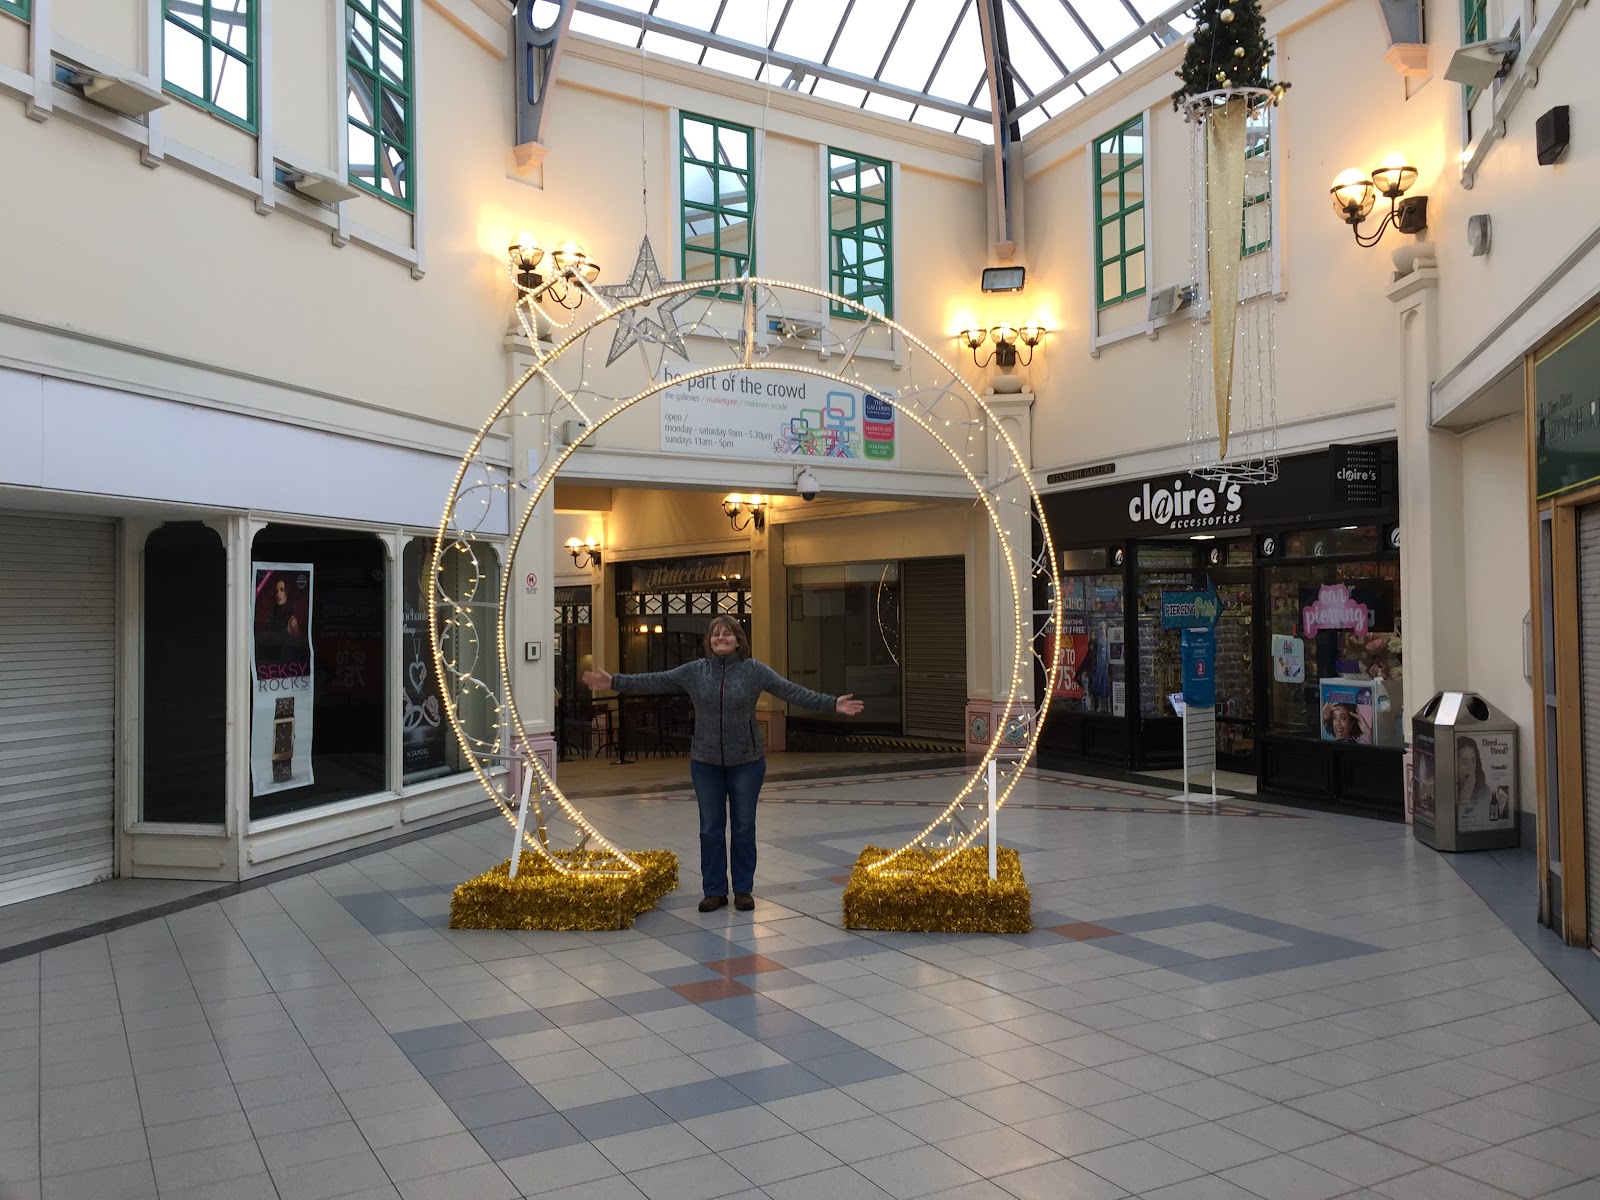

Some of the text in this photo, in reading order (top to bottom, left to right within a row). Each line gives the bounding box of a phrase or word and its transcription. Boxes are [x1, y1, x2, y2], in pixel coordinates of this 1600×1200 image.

[688, 374, 716, 392] part
[722, 374, 736, 392] of
[740, 376, 762, 395] the
[767, 383, 806, 400] crowd
[664, 392, 675, 400] the
[676, 393, 700, 402] galleries
[706, 396, 737, 407] marketgate
[664, 413, 682, 423] open
[1549, 407, 1584, 444] WATCH
[665, 423, 693, 435] monday
[699, 426, 726, 438] saturday
[728, 428, 743, 438] 9am
[749, 431, 773, 441] 5.30pm
[664, 435, 692, 446] sundays
[695, 437, 713, 447] 11am
[719, 439, 734, 449] 5pm
[1084, 465, 1112, 477] GALLERY
[1170, 511, 1241, 530] accessories
[1164, 603, 1195, 617] PIERCING
[1066, 648, 1075, 665] TO
[259, 676, 309, 692] ROCKS
[1482, 738, 1498, 747] Tired
[1491, 747, 1509, 755] Tired?
